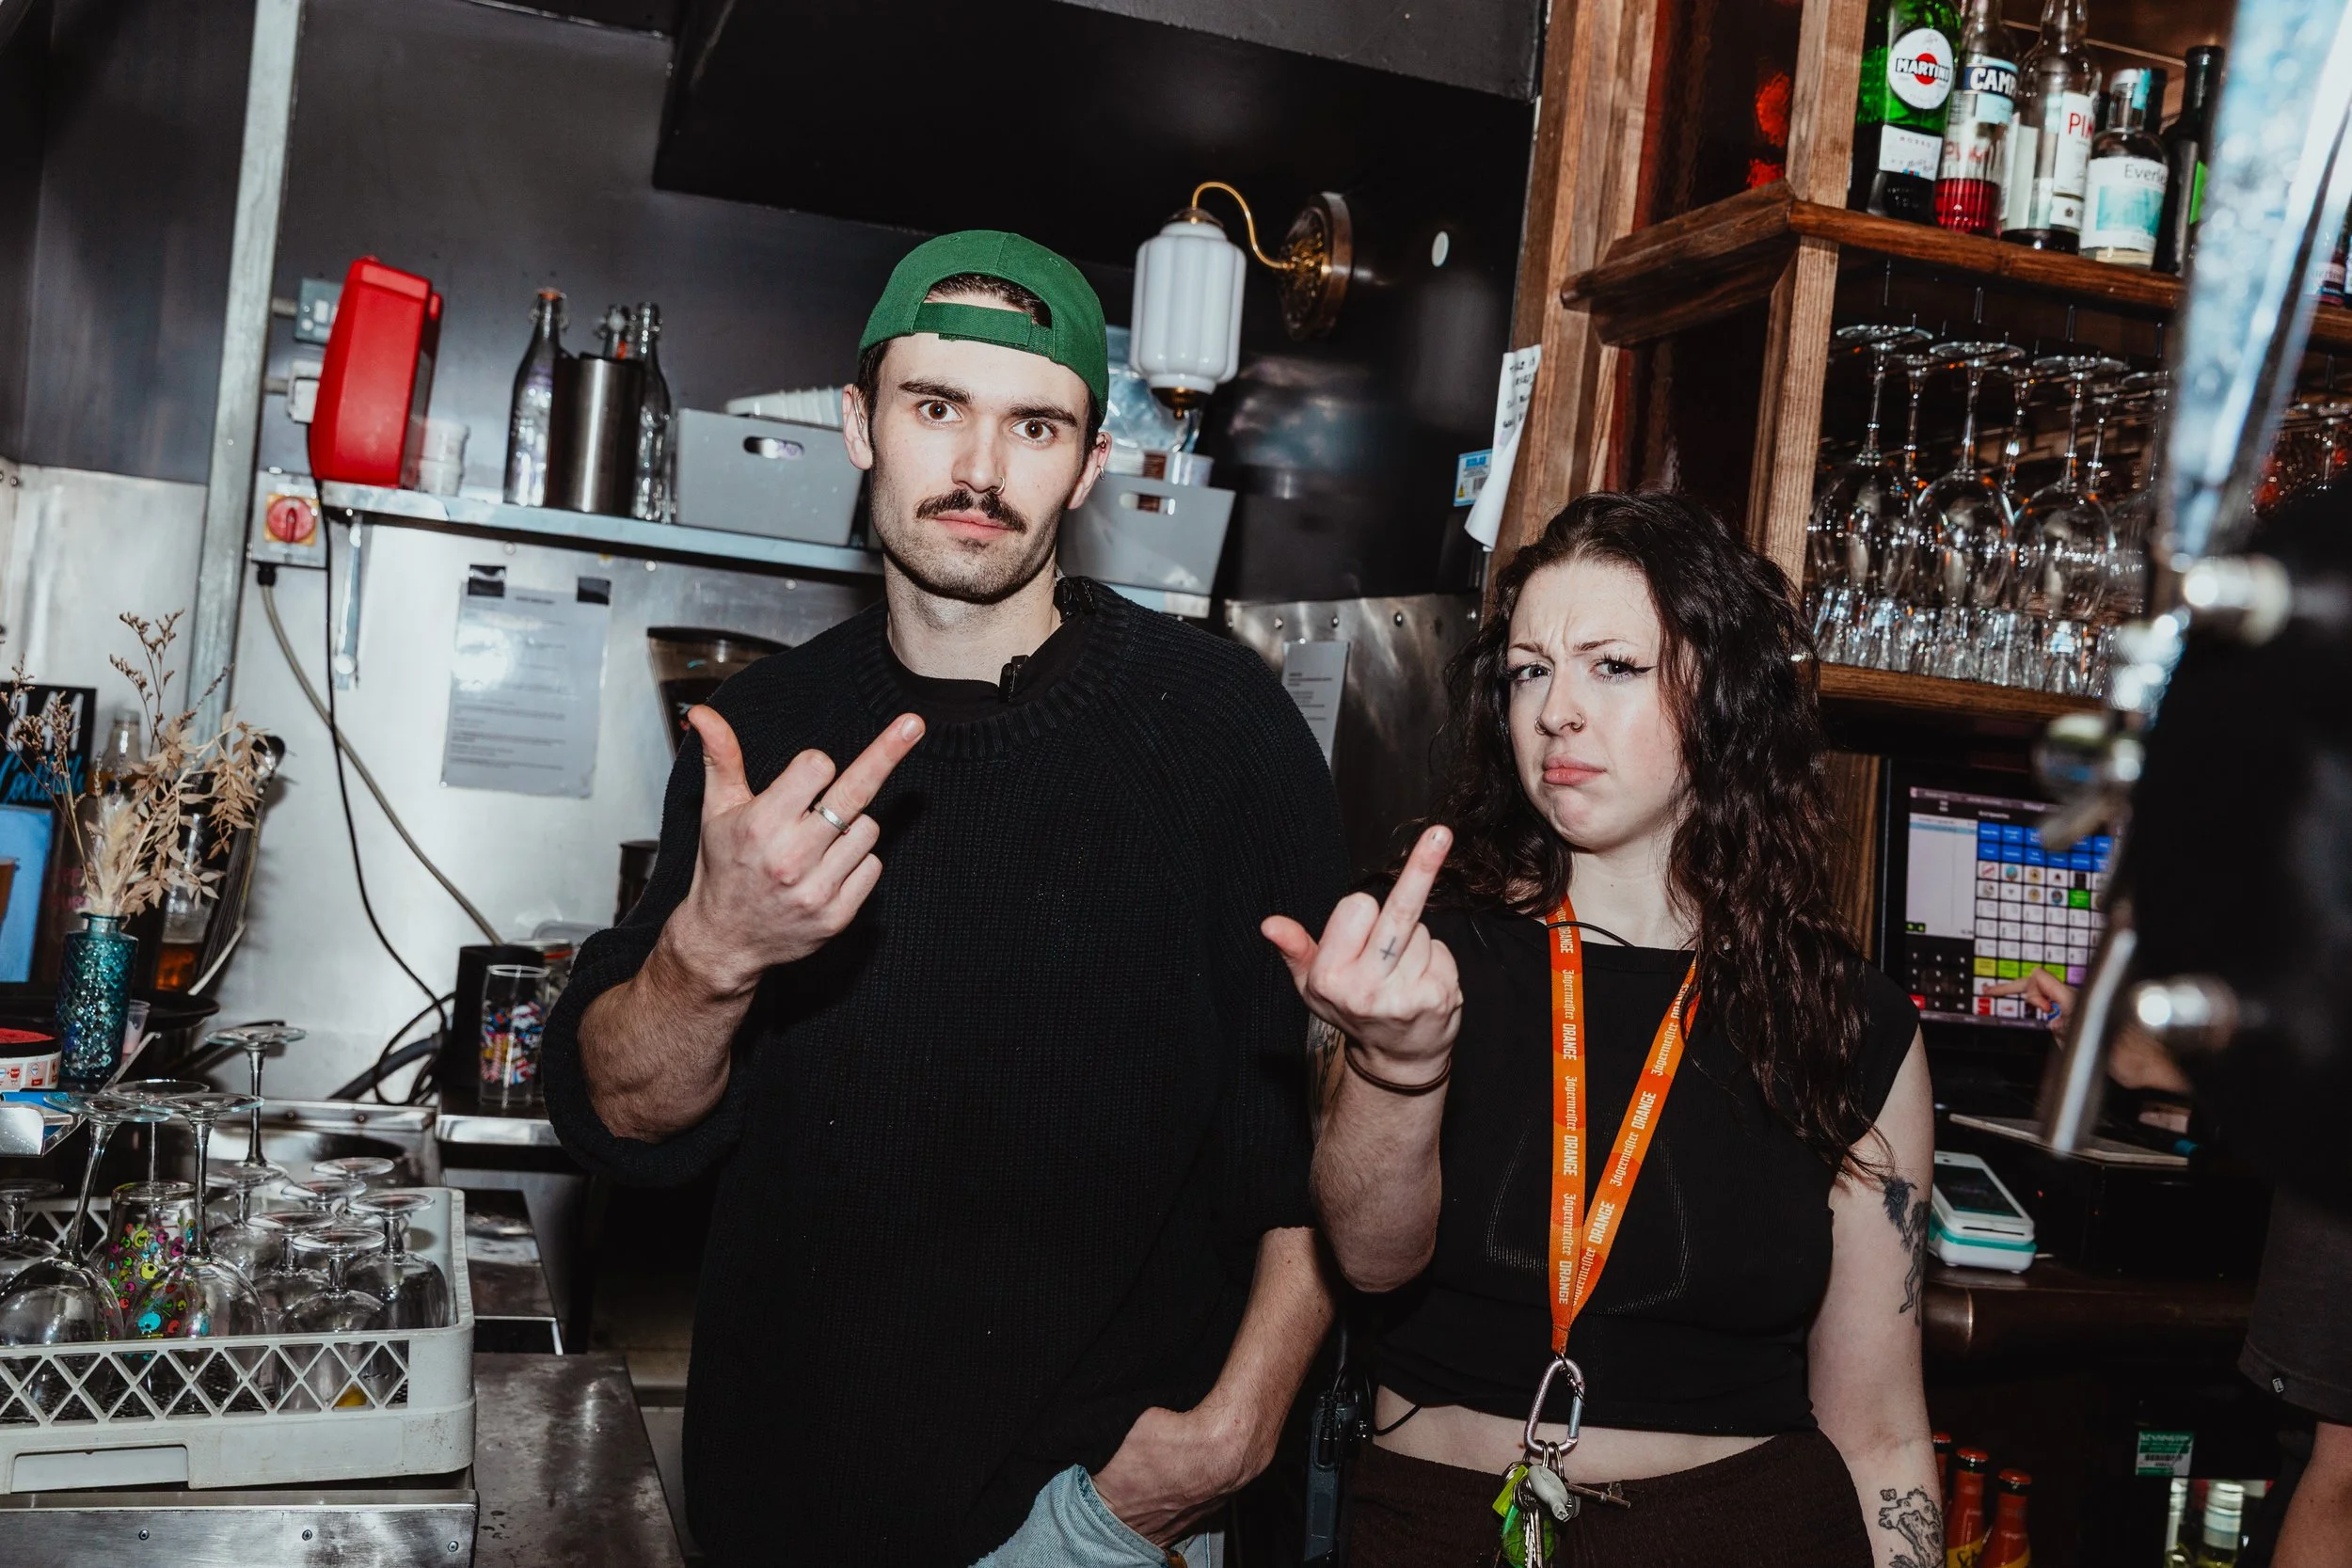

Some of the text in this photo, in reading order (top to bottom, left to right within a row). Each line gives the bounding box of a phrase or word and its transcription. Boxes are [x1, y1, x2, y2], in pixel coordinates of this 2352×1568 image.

[1896, 57, 1950, 83] MARTINI
[1563, 1023, 1577, 1061] ORANGE
[1563, 1135, 1579, 1178] ORANGE
[1588, 1200, 1615, 1245] ORANGE
[1631, 1091, 1657, 1130] ORANGE
[1558, 1260, 1573, 1306] ORANGE
